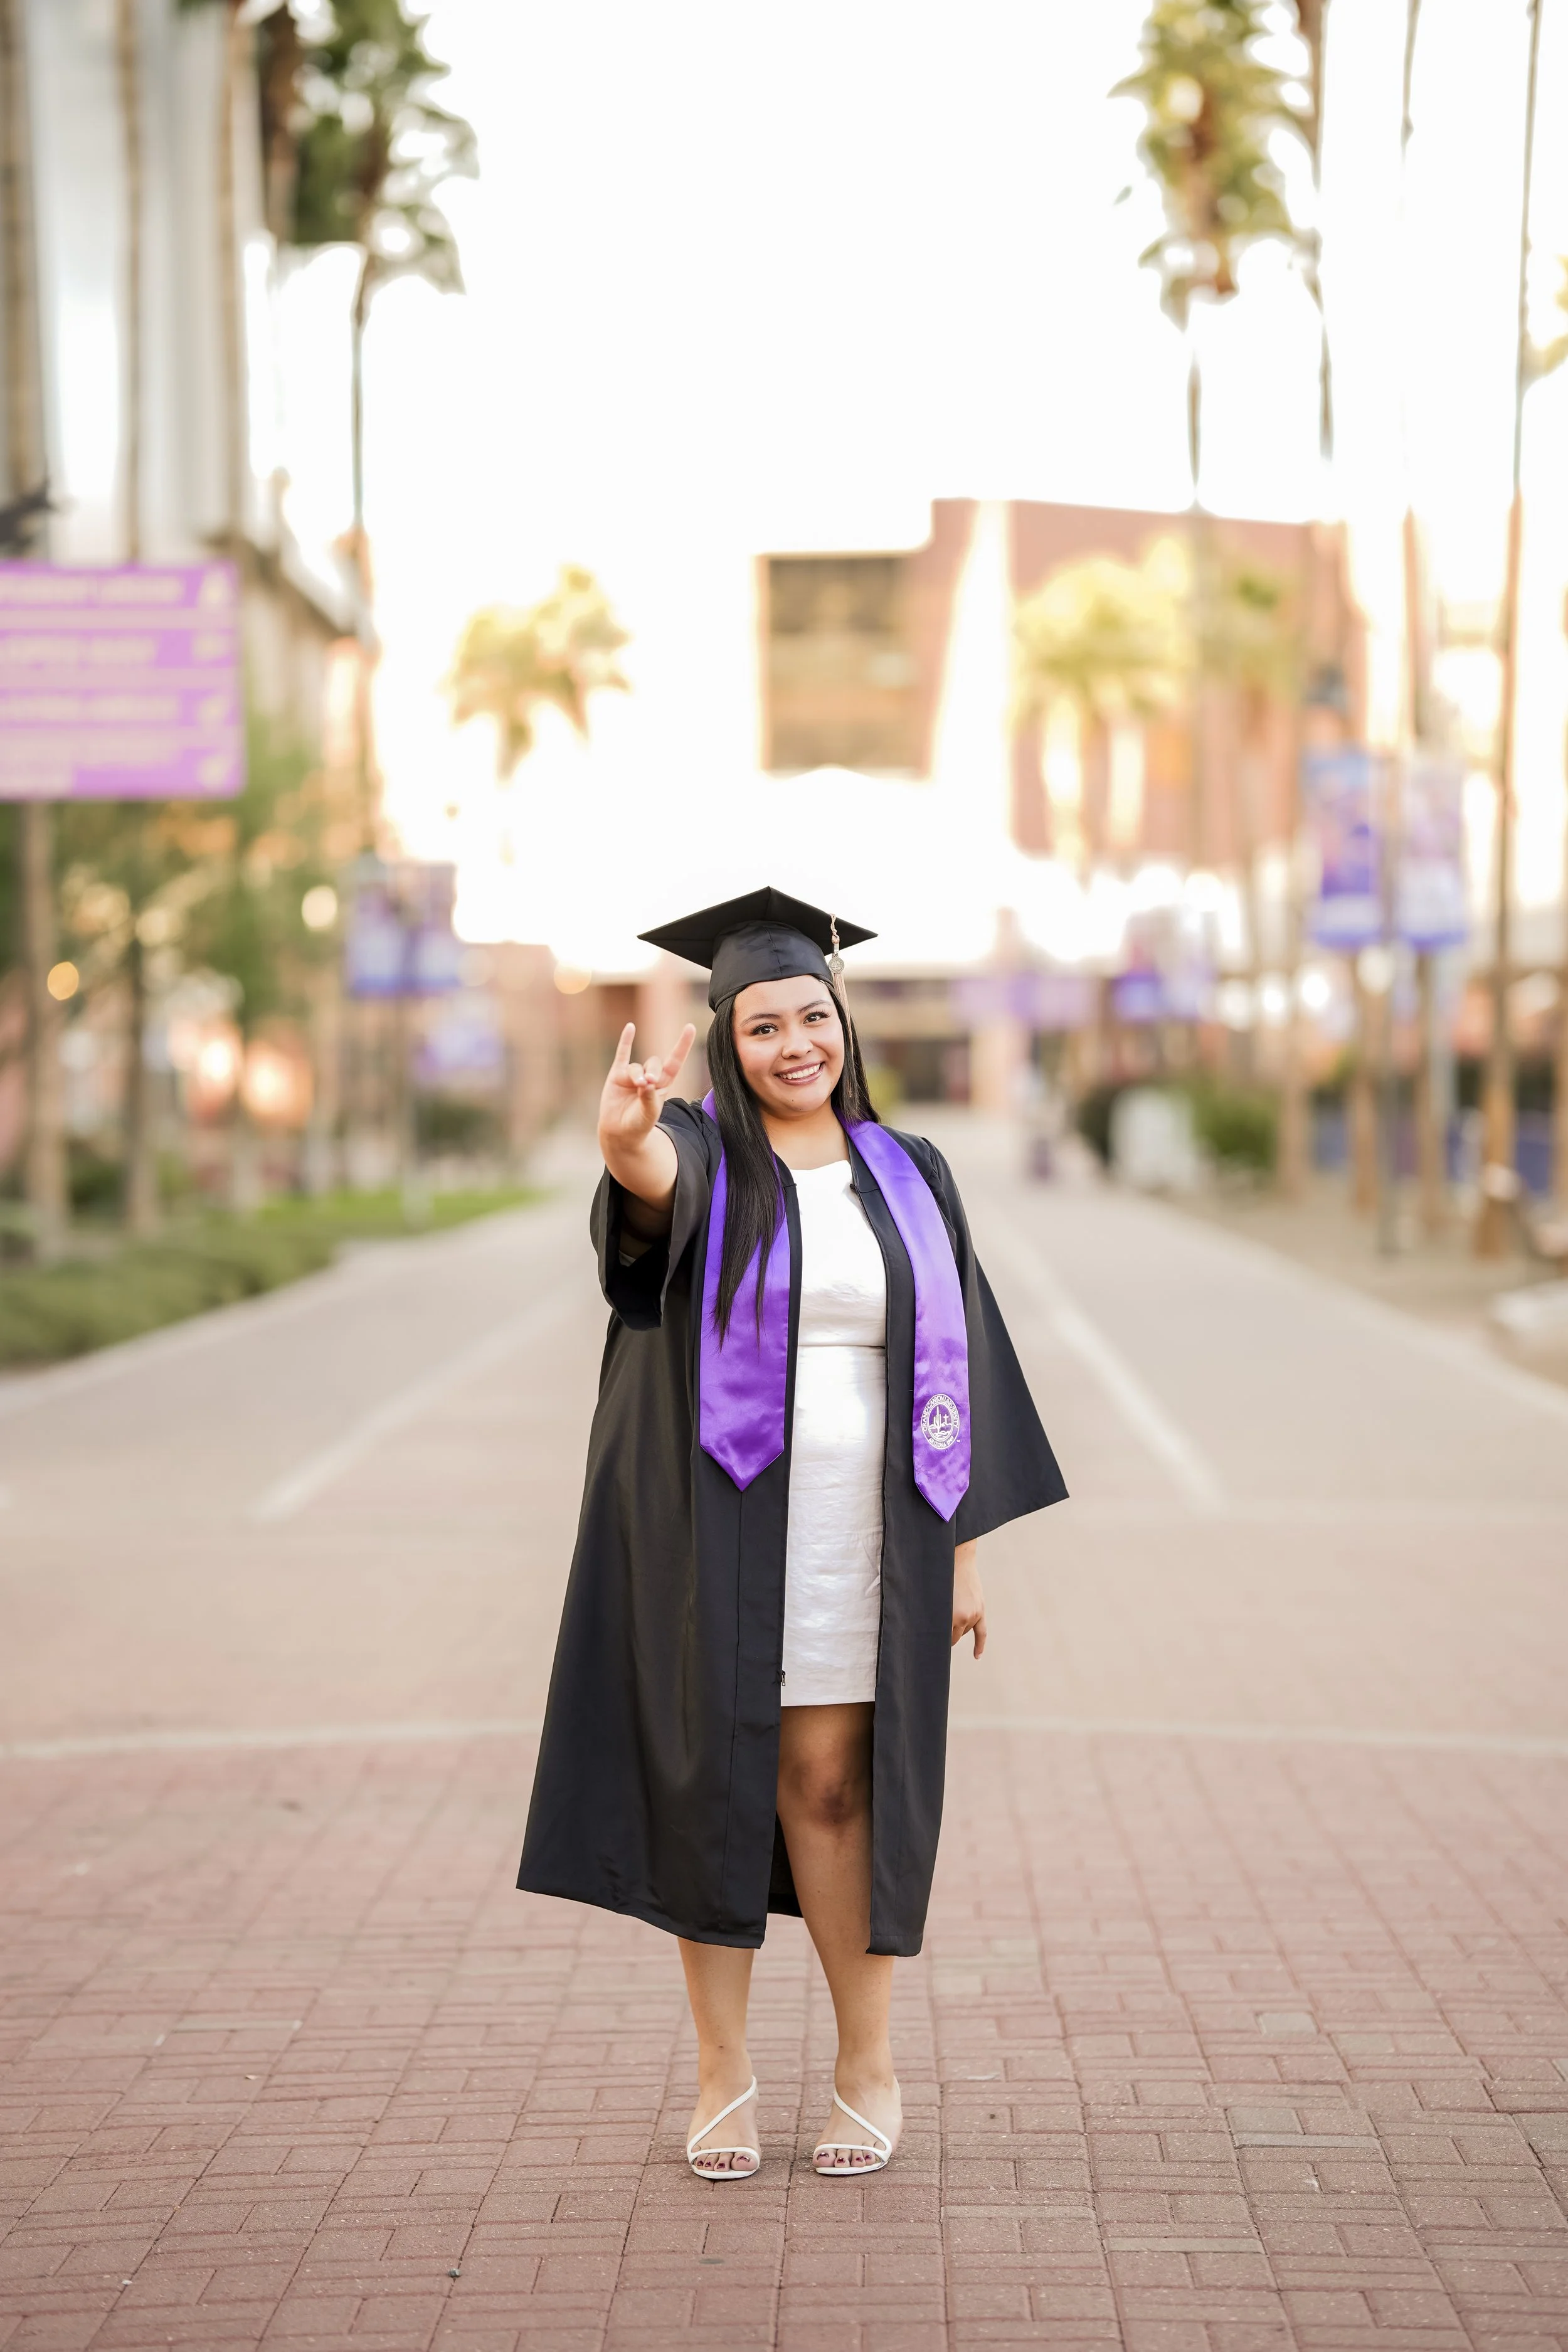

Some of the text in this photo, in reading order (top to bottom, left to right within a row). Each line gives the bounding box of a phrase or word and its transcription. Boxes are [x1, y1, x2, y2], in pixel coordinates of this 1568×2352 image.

[927, 1396, 945, 1409] CANYON
[945, 1396, 958, 1428] UNIVERSITY
[929, 1438, 946, 1448] ARIZONA
